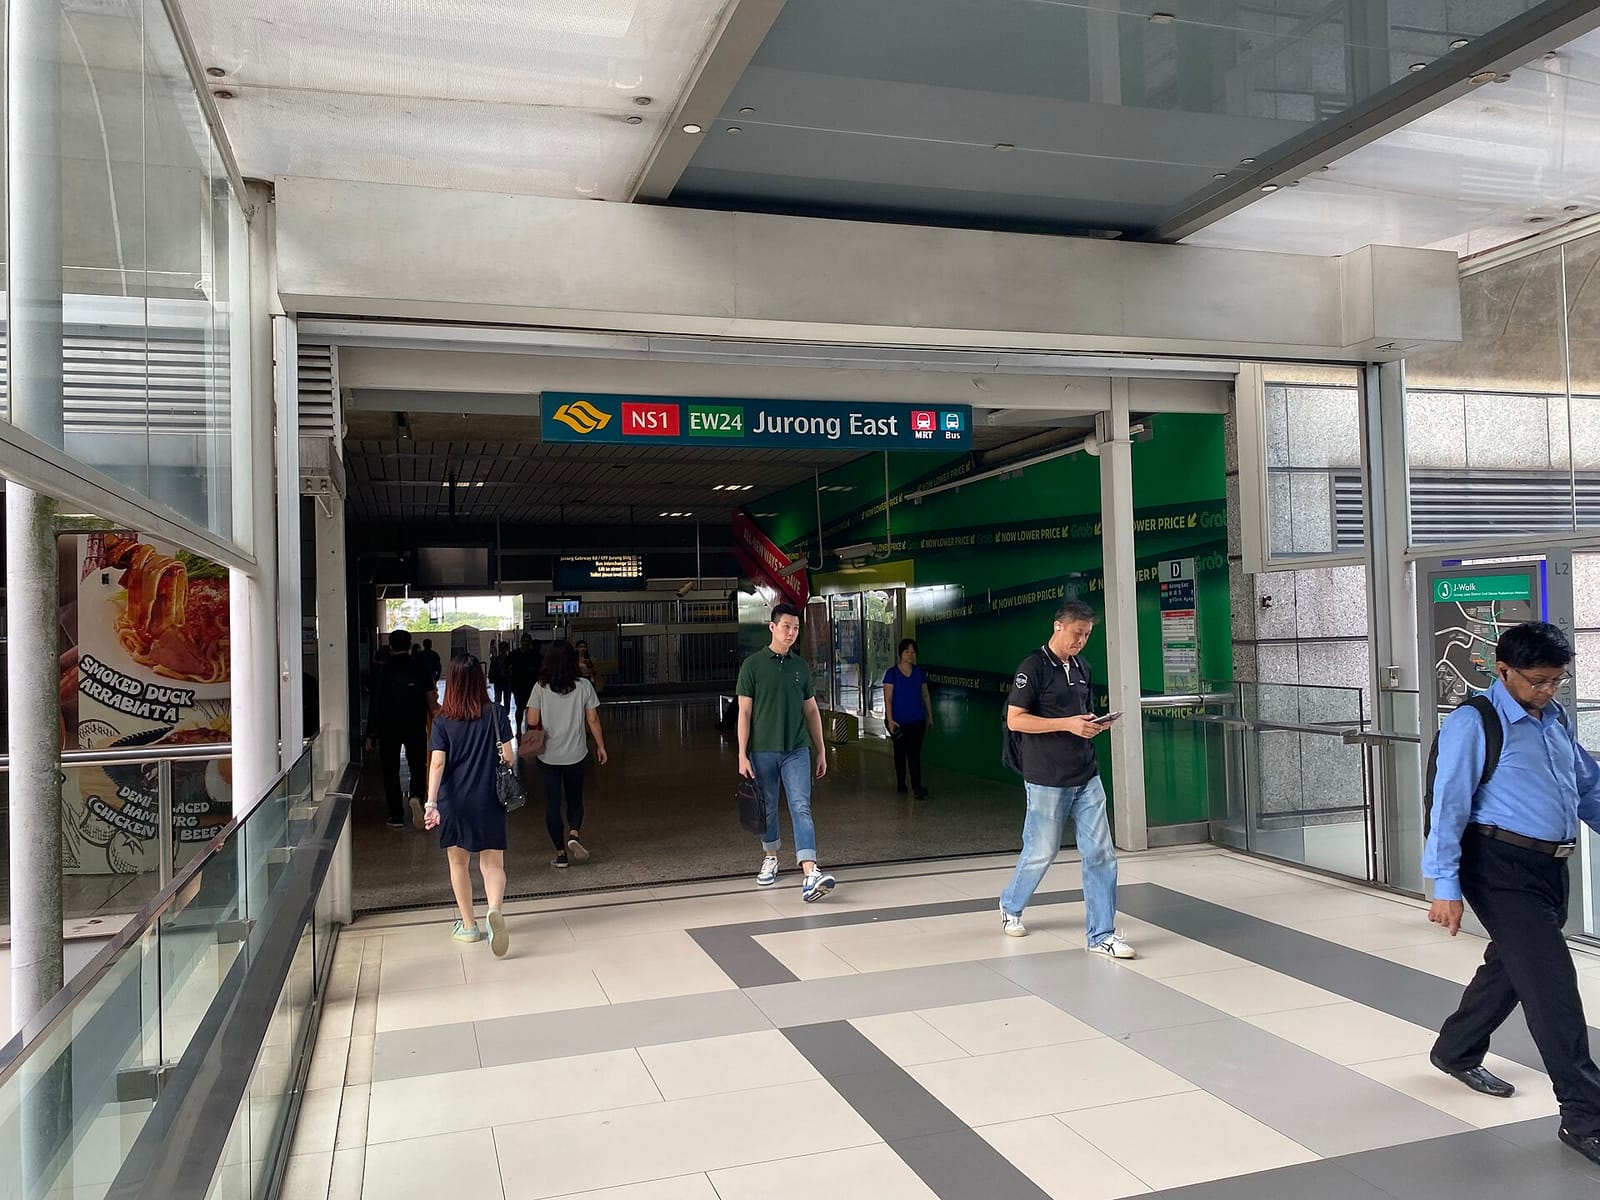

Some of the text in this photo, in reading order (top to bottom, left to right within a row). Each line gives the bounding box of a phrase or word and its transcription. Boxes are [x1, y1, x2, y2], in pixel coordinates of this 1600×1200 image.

[632, 411, 669, 429] NS1
[690, 412, 743, 431] EW24
[753, 411, 898, 439] Jurong East
[915, 431, 932, 439] MRT
[945, 431, 961, 439] Bus
[1158, 516, 1185, 530] PRICE
[1001, 527, 1061, 543] NOW LOWER PRICE
[1172, 563, 1180, 577] D
[1555, 562, 1569, 575] L2
[1453, 583, 1476, 592] J-Walk
[998, 597, 1013, 609] NOW
[1013, 593, 1036, 606] LOWER
[1037, 588, 1057, 601] PRICE
[80, 656, 193, 706] SMOKED DUCK
[80, 678, 177, 722] ARRABIATA
[1165, 706, 1192, 719] PRICE
